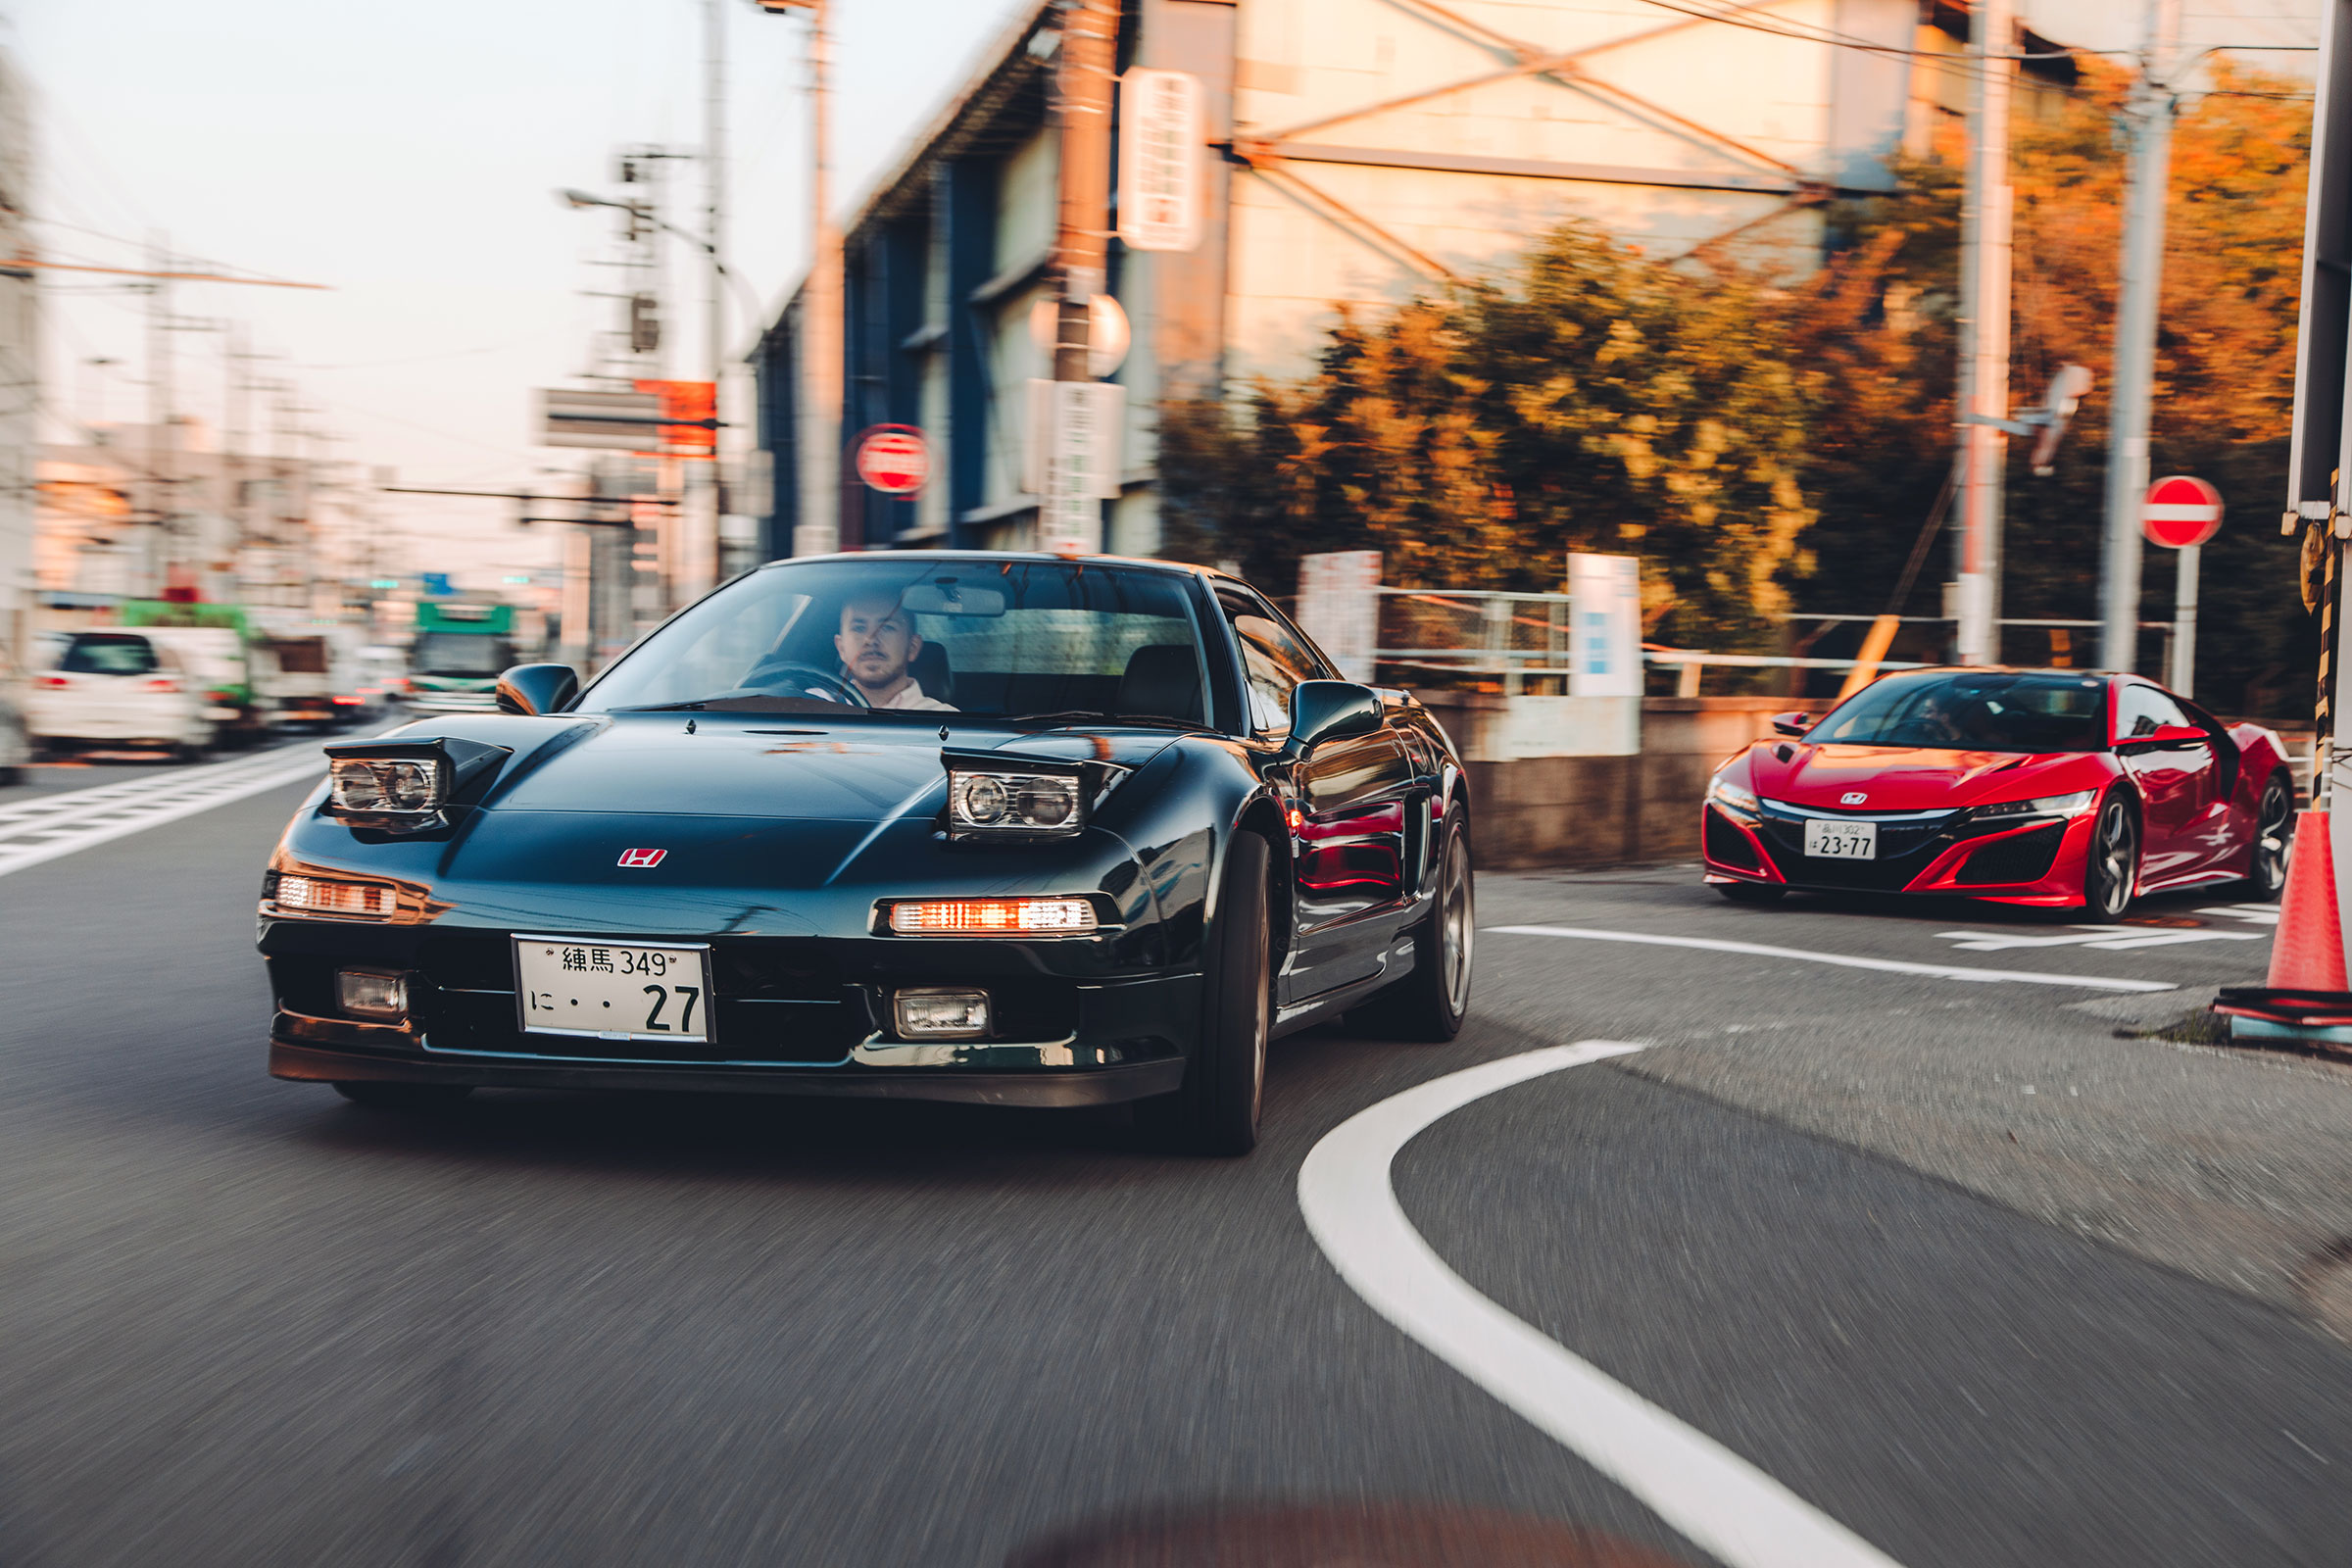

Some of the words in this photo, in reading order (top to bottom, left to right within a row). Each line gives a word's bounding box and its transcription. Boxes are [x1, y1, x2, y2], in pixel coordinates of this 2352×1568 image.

[1820, 835, 1872, 857] 23-77
[562, 947, 614, 974] 練馬
[620, 950, 667, 977] 349
[530, 990, 555, 1011] に
[642, 984, 700, 1032] 27
